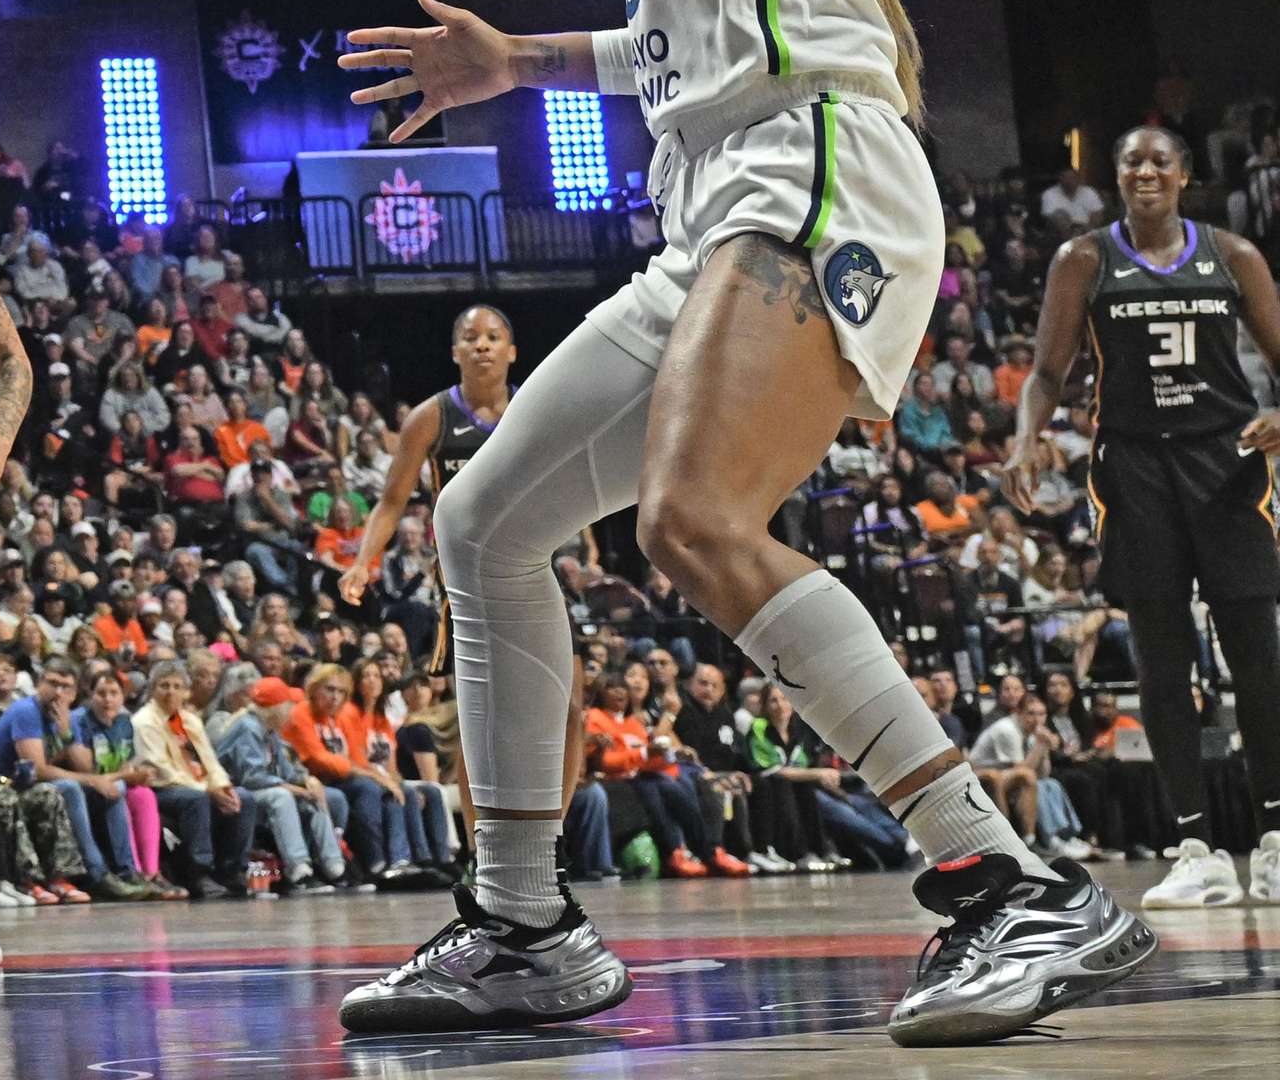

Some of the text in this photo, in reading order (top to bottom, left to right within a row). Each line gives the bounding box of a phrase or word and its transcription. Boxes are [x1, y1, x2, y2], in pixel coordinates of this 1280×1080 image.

[642, 70, 681, 109] NIC
[1109, 299, 1229, 320] KEESUSK
[1148, 321, 1196, 367] 31
